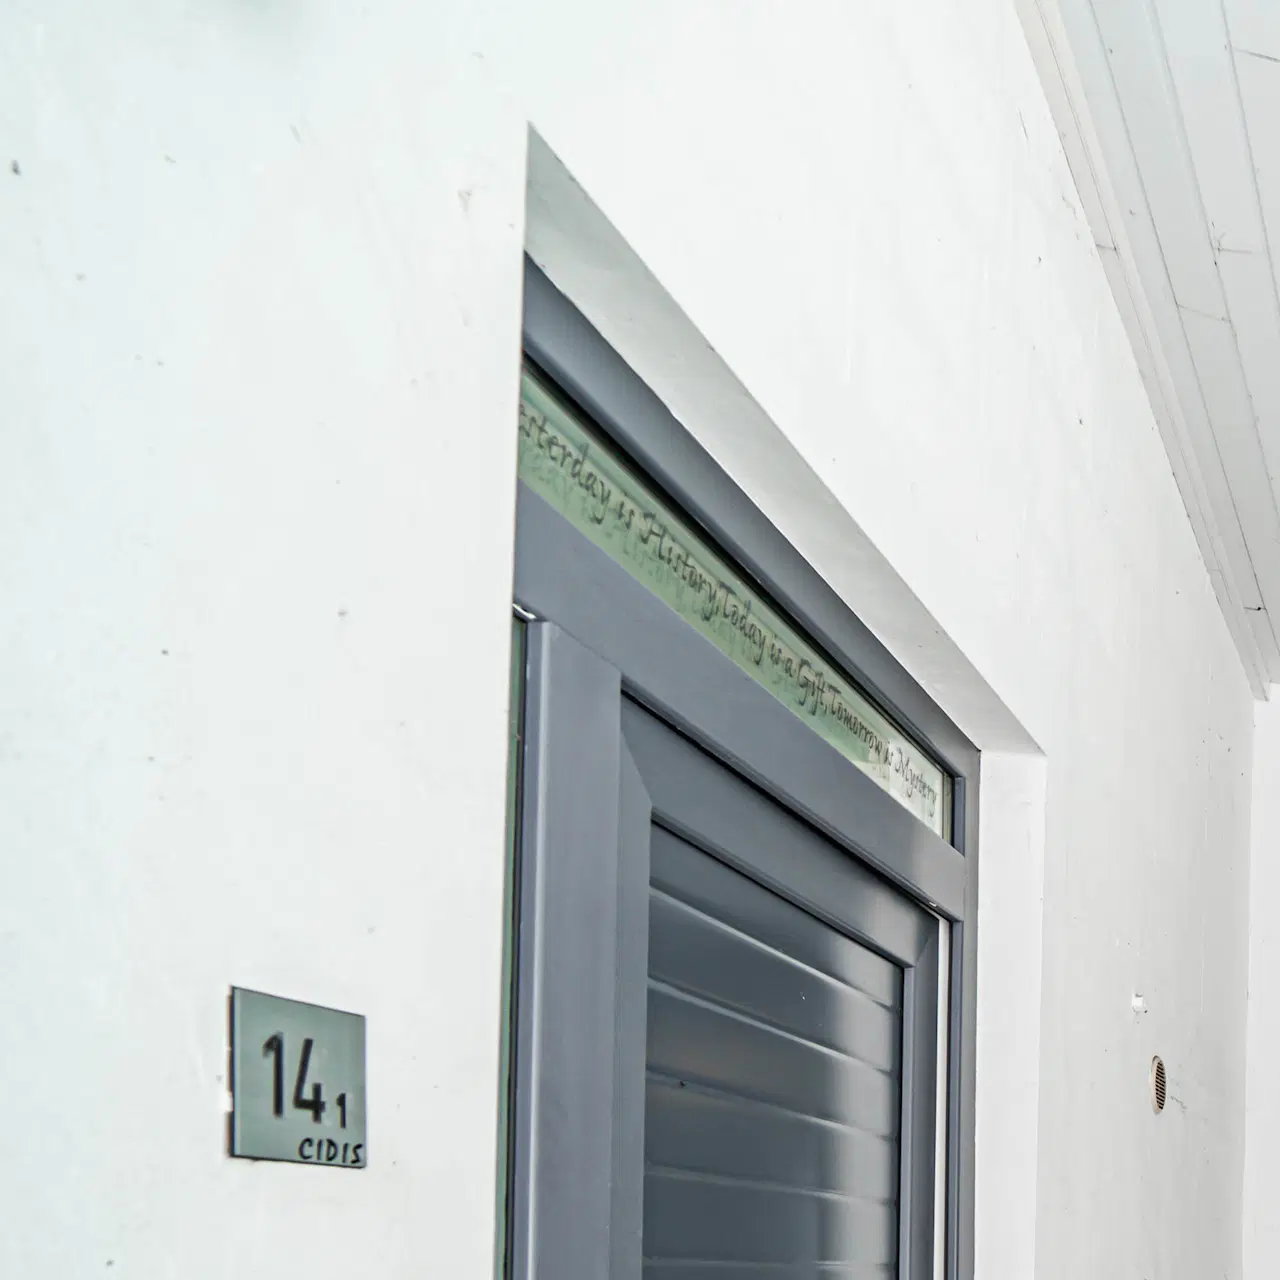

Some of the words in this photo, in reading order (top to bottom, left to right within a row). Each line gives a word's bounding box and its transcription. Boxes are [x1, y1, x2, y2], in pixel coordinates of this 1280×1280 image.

[614, 492, 635, 530] is
[719, 581, 766, 666] Today
[769, 634, 782, 667] is
[828, 684, 884, 758] Tomorrow
[895, 747, 937, 818] Mystery
[299, 1137, 363, 1164] CIDIS
